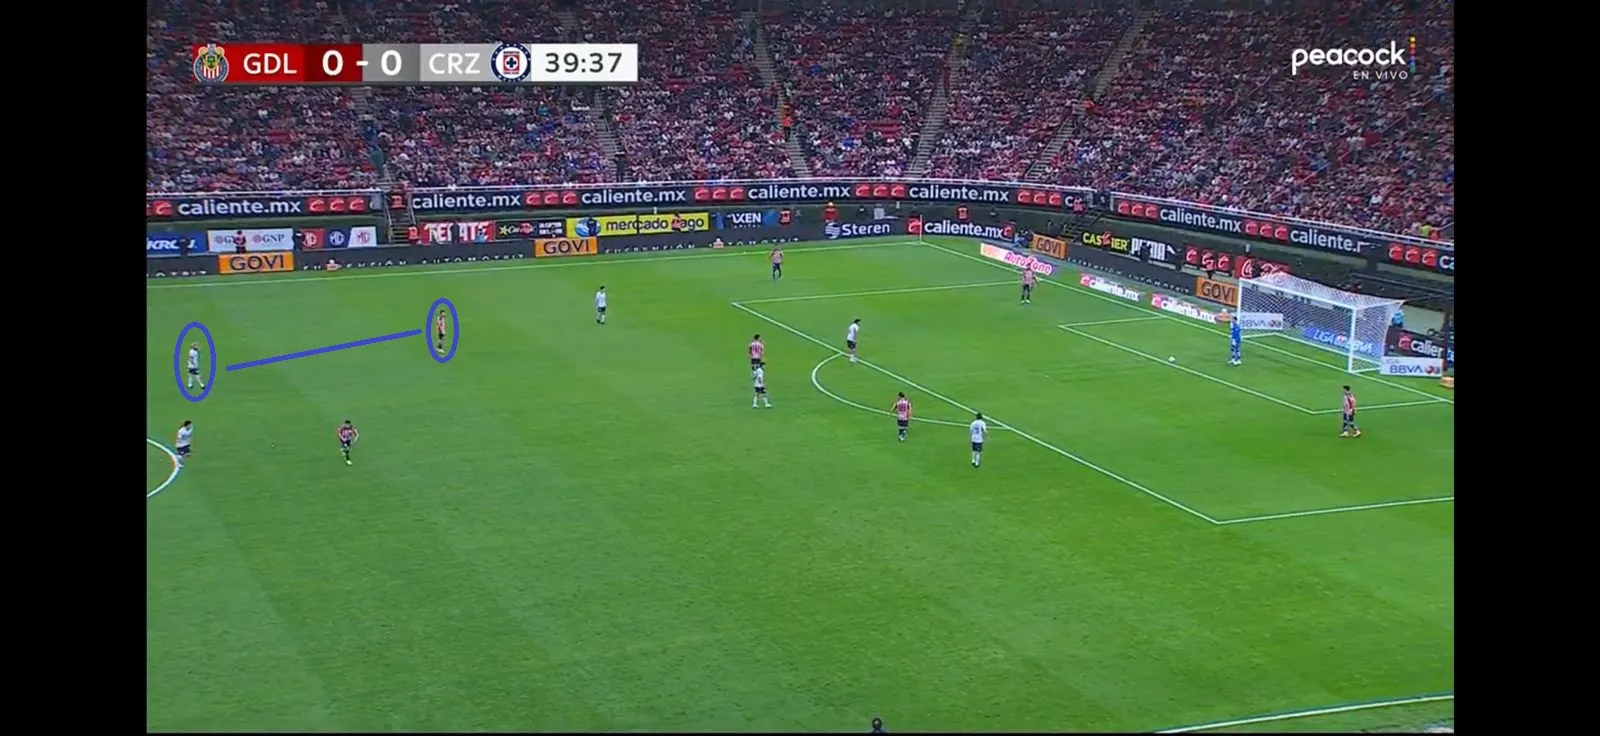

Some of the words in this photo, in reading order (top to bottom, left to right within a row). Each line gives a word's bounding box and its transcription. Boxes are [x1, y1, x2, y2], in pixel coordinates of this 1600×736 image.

[581, 189, 686, 204] caliente.mx
[748, 185, 850, 199] caliente.mx
[909, 184, 1009, 201] caliente.mx
[178, 199, 301, 215] caliente.mx
[412, 194, 521, 209] caliente.mx
[606, 217, 668, 231] mercado
[1160, 208, 1242, 232] caliente.mx
[841, 222, 890, 236] Steren
[924, 220, 1004, 239] caliente.mx
[543, 240, 590, 254] GOVI
[1036, 238, 1062, 257] GOVI
[1082, 232, 1128, 251] CASIER
[229, 254, 285, 270] GOVI
[1004, 251, 1053, 275] AutoZone
[1201, 281, 1236, 303] GOVI
[1389, 365, 1423, 374] BBVA
